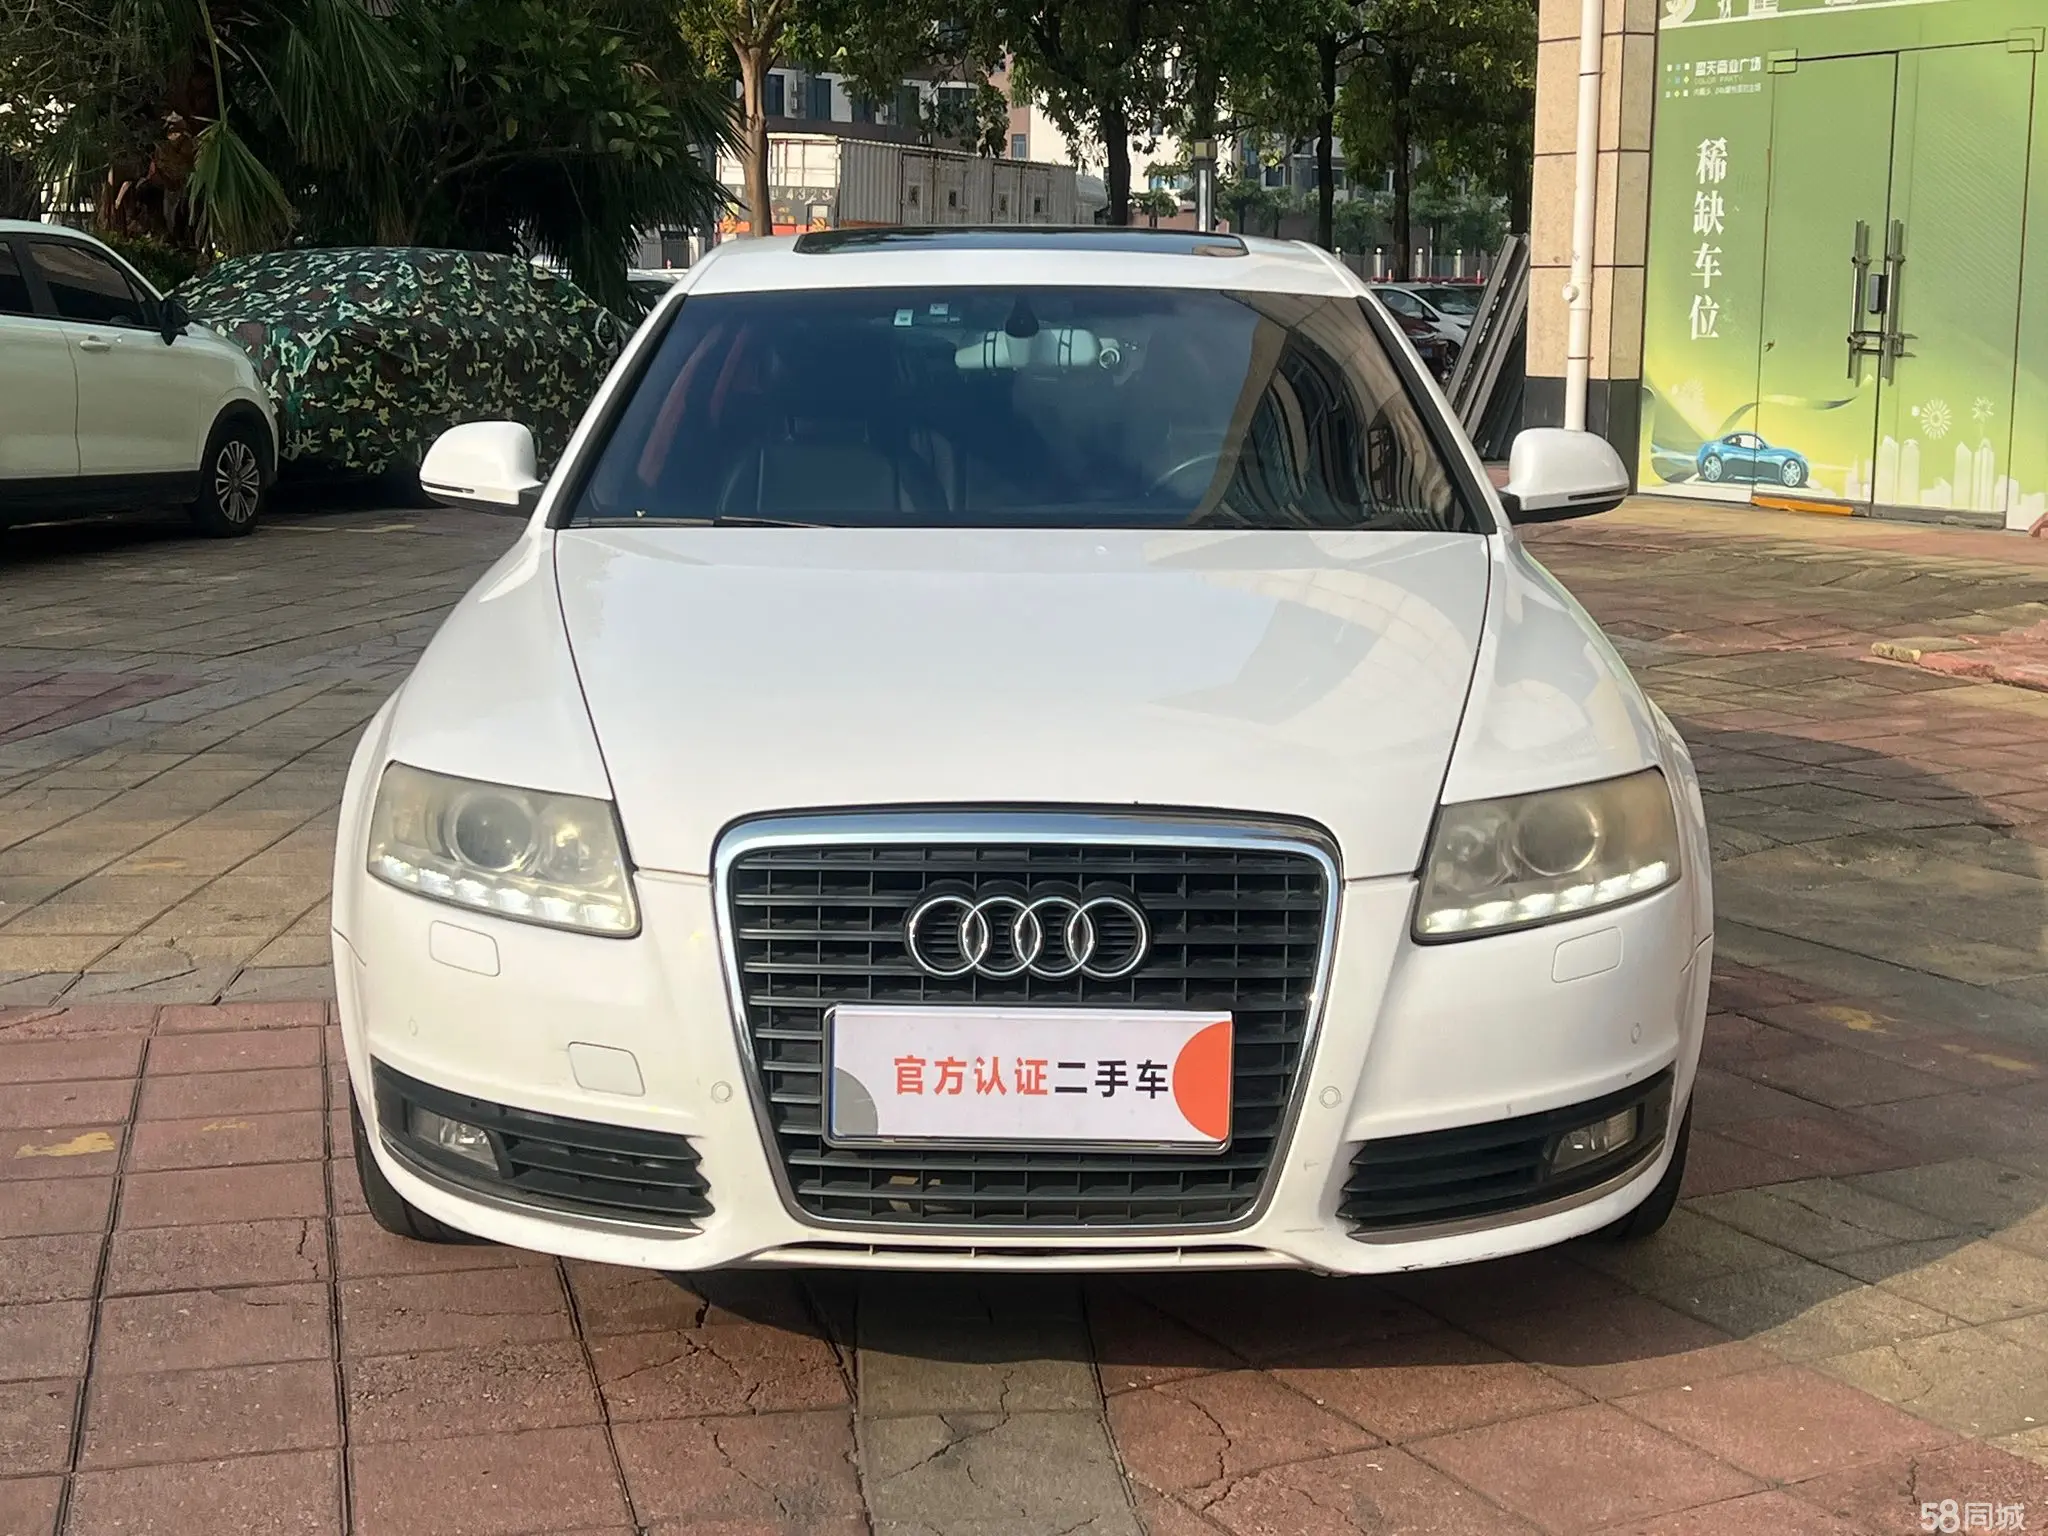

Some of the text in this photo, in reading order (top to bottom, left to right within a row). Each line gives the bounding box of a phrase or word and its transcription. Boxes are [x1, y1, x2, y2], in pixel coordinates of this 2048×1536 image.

[1689, 137, 1728, 341] 稀缺车位
[894, 1055, 1169, 1099] 官方认证二手车
